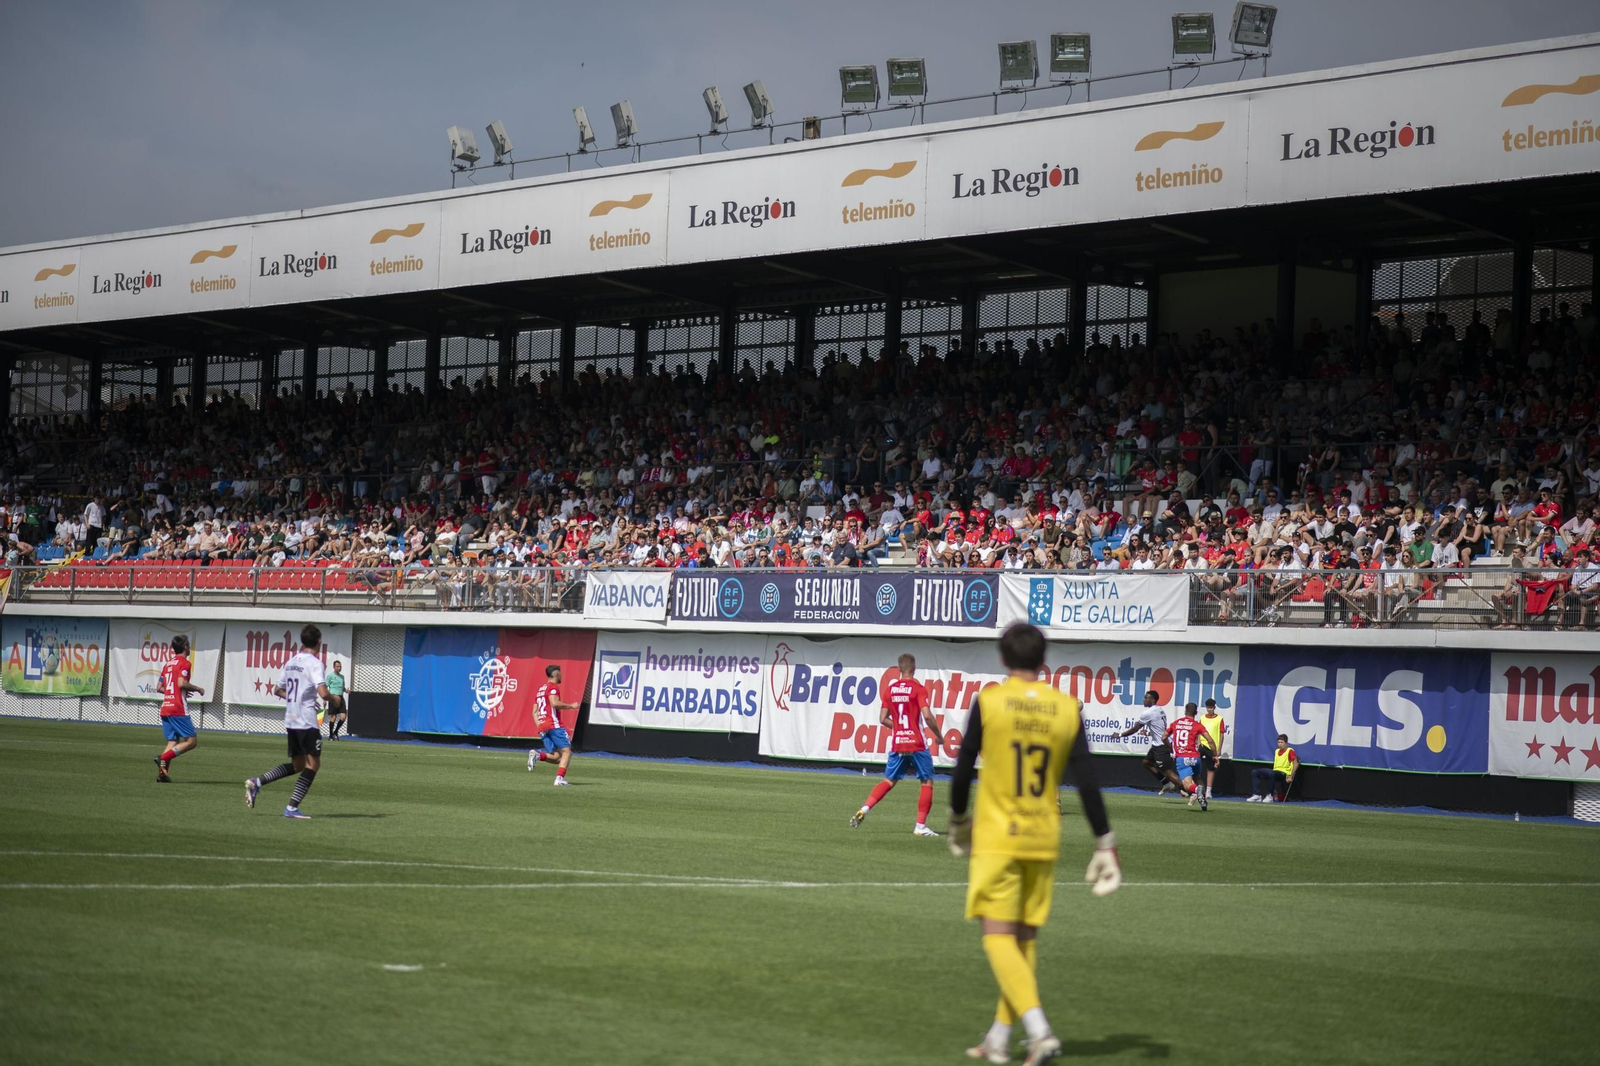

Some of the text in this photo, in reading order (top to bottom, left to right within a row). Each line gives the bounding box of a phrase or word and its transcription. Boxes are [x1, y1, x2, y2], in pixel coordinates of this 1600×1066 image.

[1280, 121, 1435, 162] La Región
[1502, 120, 1600, 152] telemiñ
[952, 162, 1079, 199] La Región
[1135, 163, 1223, 192] telemiño
[688, 196, 796, 228] La Región
[842, 198, 915, 224] telemiño
[460, 224, 552, 254] La Región
[589, 228, 651, 251] telemiño
[259, 252, 337, 278] La Región
[369, 254, 424, 276] telemiño
[92, 270, 162, 295] La Región
[189, 274, 236, 294] telemiño
[34, 291, 75, 309] telemiño
[589, 584, 665, 608] ABANCA
[794, 578, 861, 607] SEGUNDA
[1063, 581, 1120, 600] XUNTA
[793, 608, 860, 620] FEDERACIÓN
[1061, 604, 1154, 624] DE GALICIA
[141, 640, 177, 662] CORE
[645, 646, 760, 678] hormigones
[165, 673, 174, 694] 14
[287, 678, 299, 703] 21
[641, 681, 758, 717] BARBADÁS
[898, 703, 909, 729] 4
[1085, 718, 1122, 730] gasoleo,
[1131, 734, 1149, 745] aire
[1176, 729, 1189, 747] 19
[1010, 740, 1051, 798] 13
